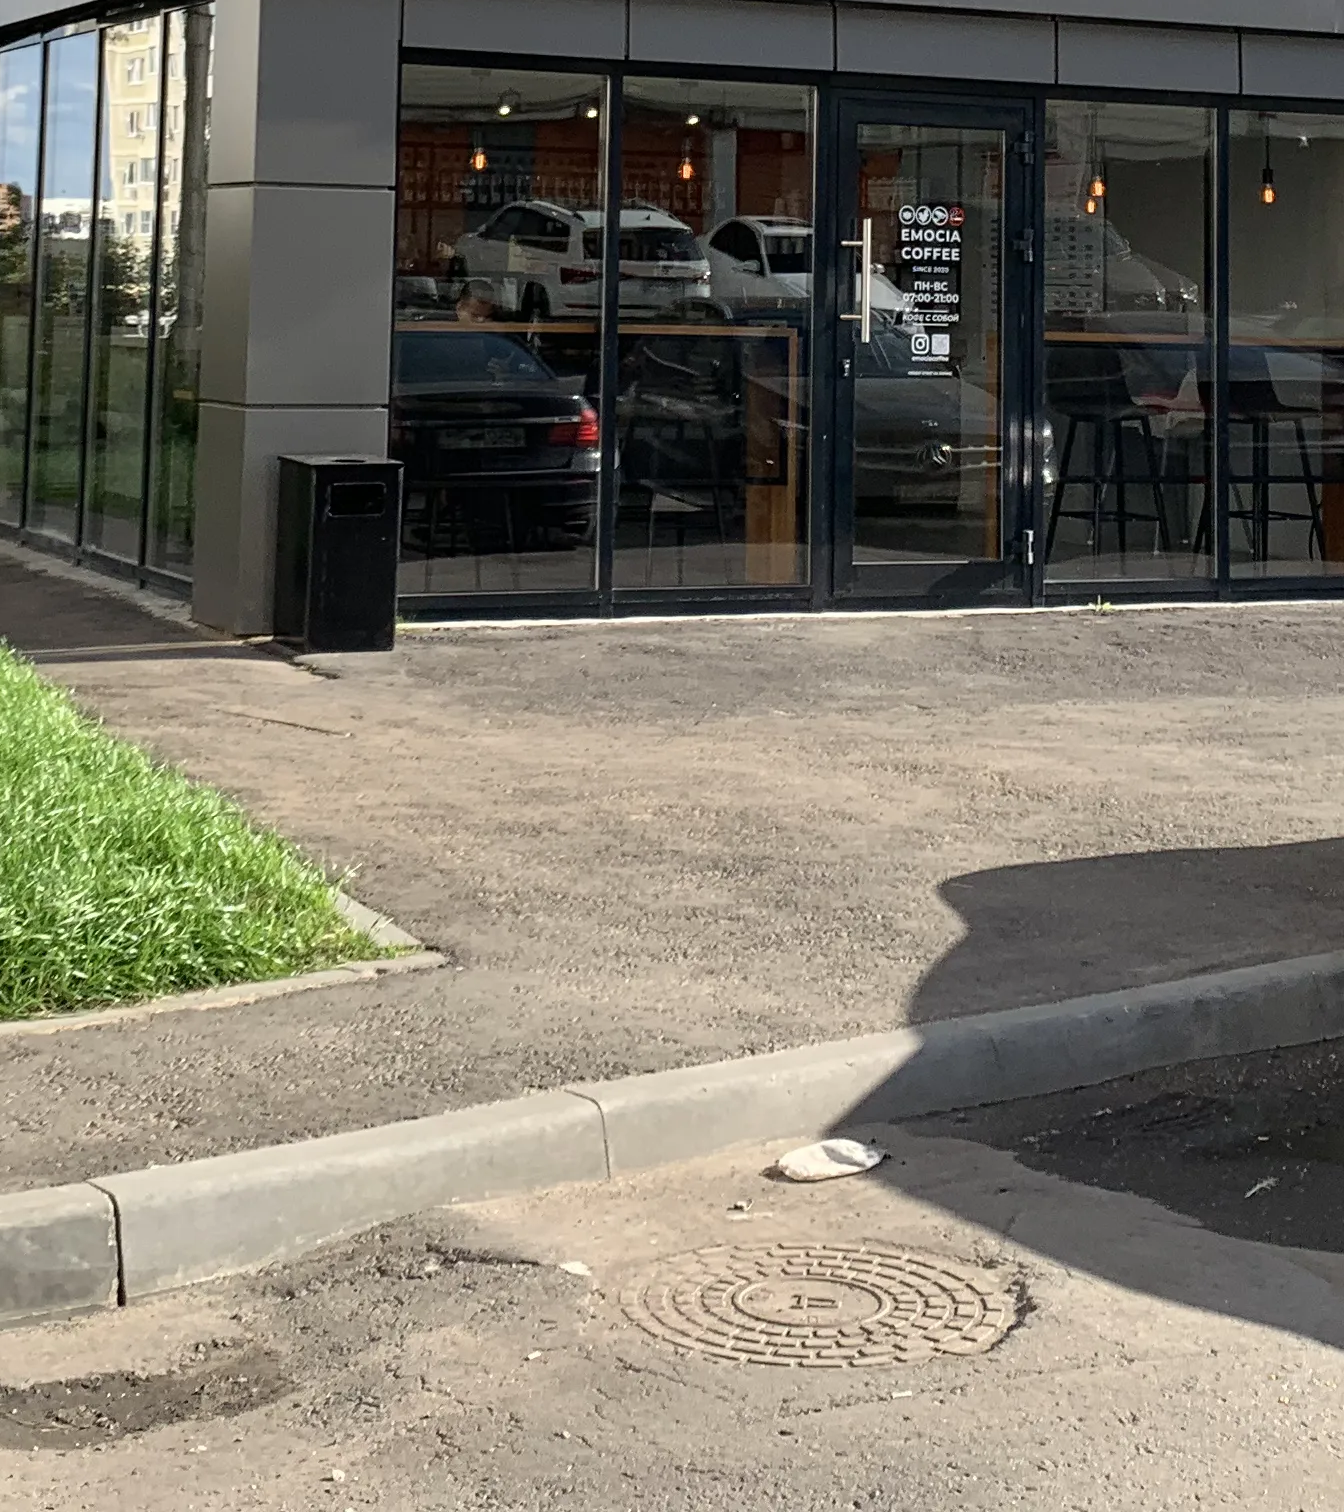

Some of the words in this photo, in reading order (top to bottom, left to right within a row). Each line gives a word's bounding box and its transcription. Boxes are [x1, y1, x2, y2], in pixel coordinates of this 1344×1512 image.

[901, 228, 962, 243] EMOCIA
[901, 246, 961, 261] COFFEE
[913, 280, 948, 291] ПН-ВС
[902, 292, 959, 304] 07:00-21:00
